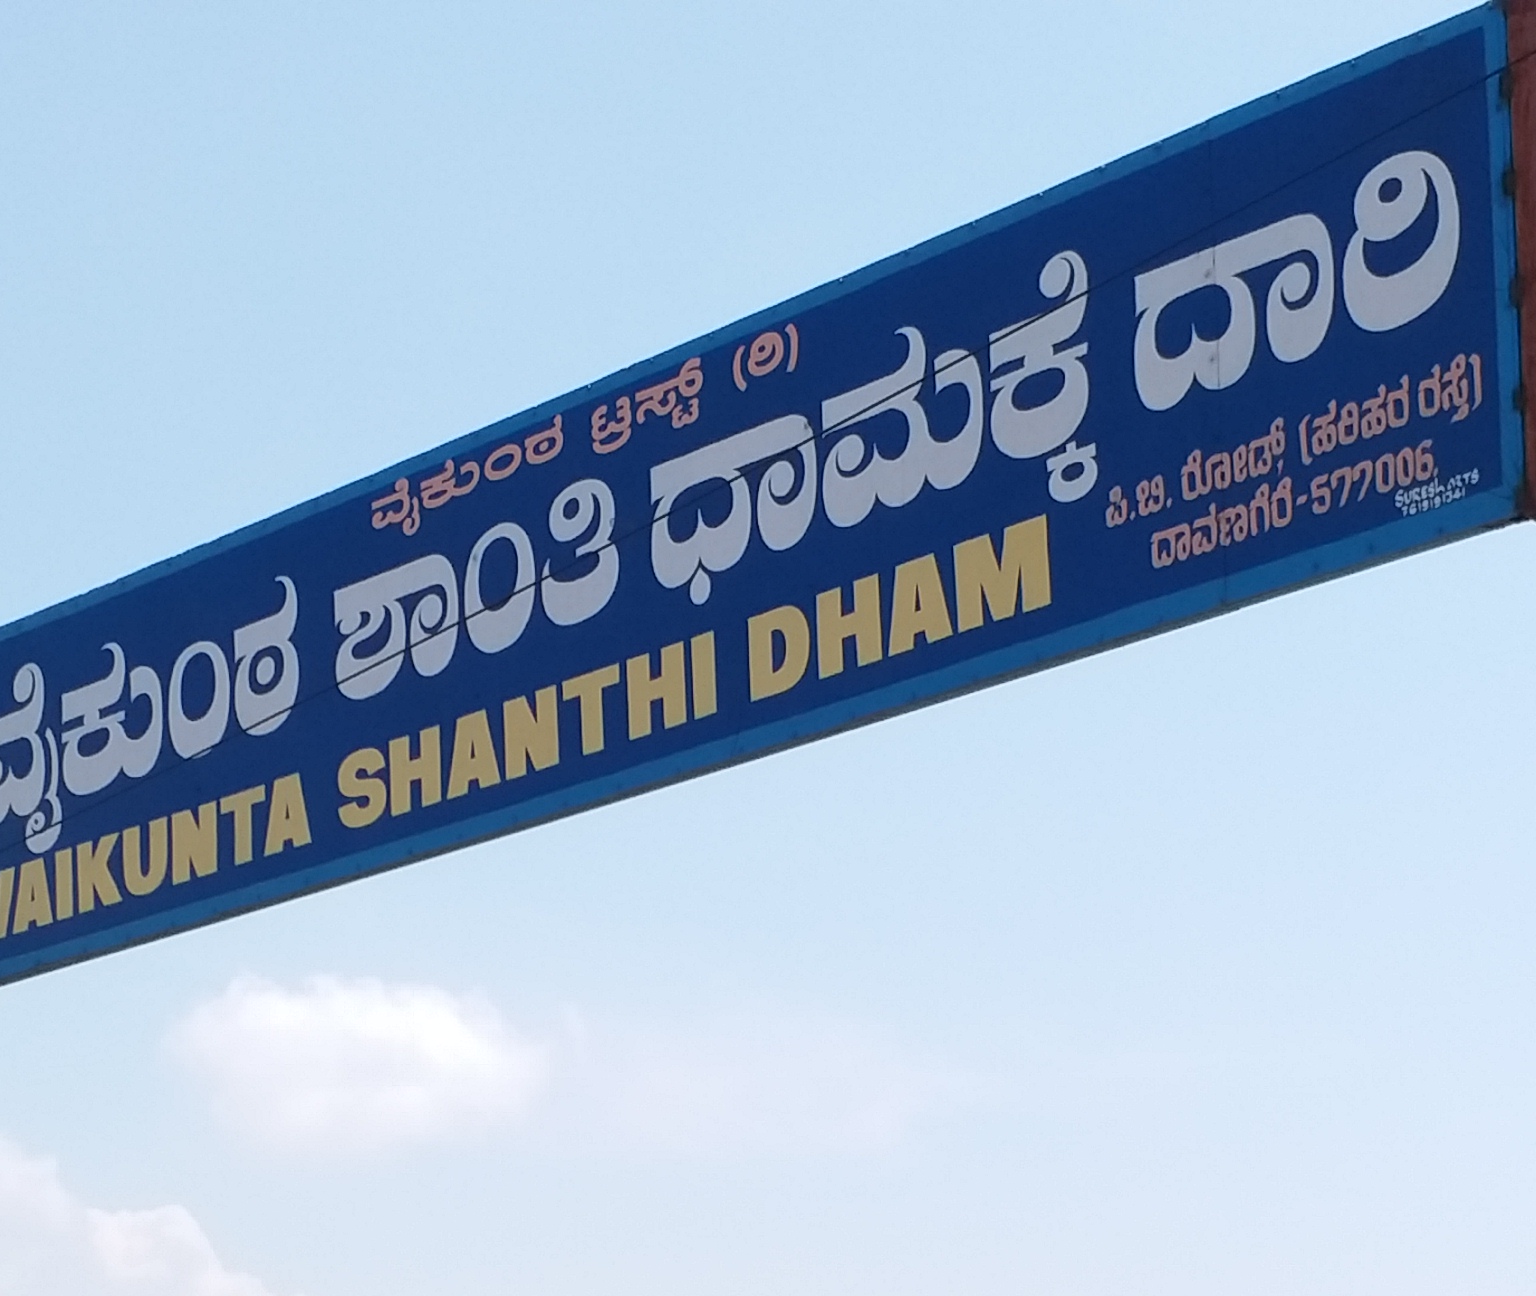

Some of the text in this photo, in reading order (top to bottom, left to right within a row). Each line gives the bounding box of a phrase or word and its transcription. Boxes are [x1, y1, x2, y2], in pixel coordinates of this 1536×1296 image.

[334, 478, 620, 700] ಶಾಂತಿ
[649, 249, 1099, 605] ಧಾಮಕ್ಕೆ
[1134, 150, 1460, 411] ದಾರಿ
[371, 324, 799, 536] ವೈಕುಂಠ ಟ್ರಸ್ಟ್ (ರಿ)
[1299, 374, 1410, 465] (ಹರಿಹರ
[337, 630, 718, 829] SHANTHI
[746, 513, 1053, 703] DHAM
